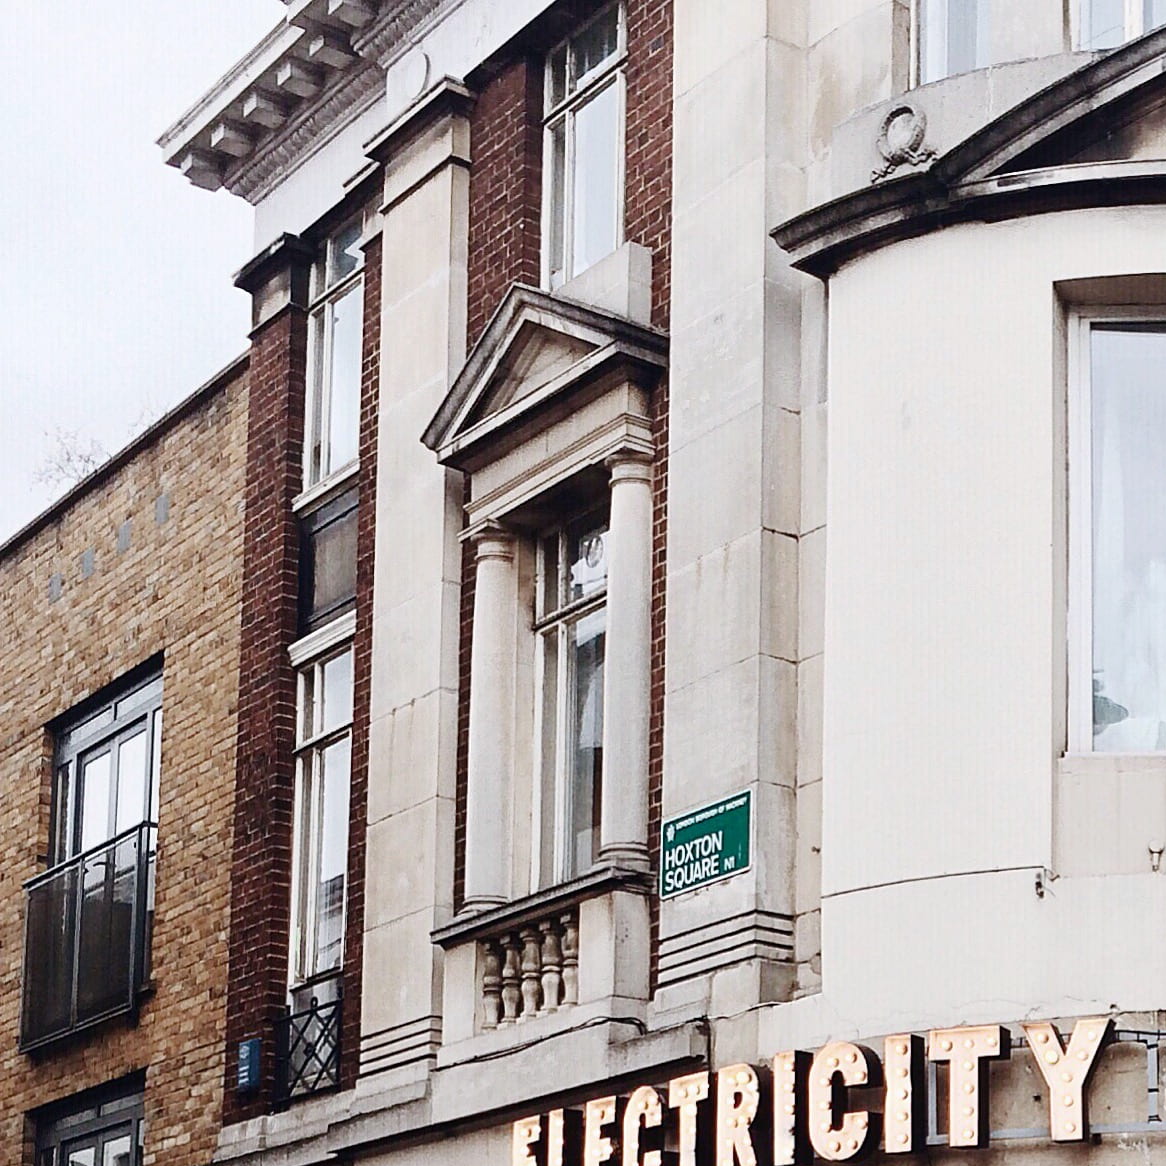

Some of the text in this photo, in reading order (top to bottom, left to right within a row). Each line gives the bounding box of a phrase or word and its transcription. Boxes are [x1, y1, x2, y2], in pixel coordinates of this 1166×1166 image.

[665, 830, 723, 870] HOXTON
[664, 854, 735, 892] SQUARE N1
